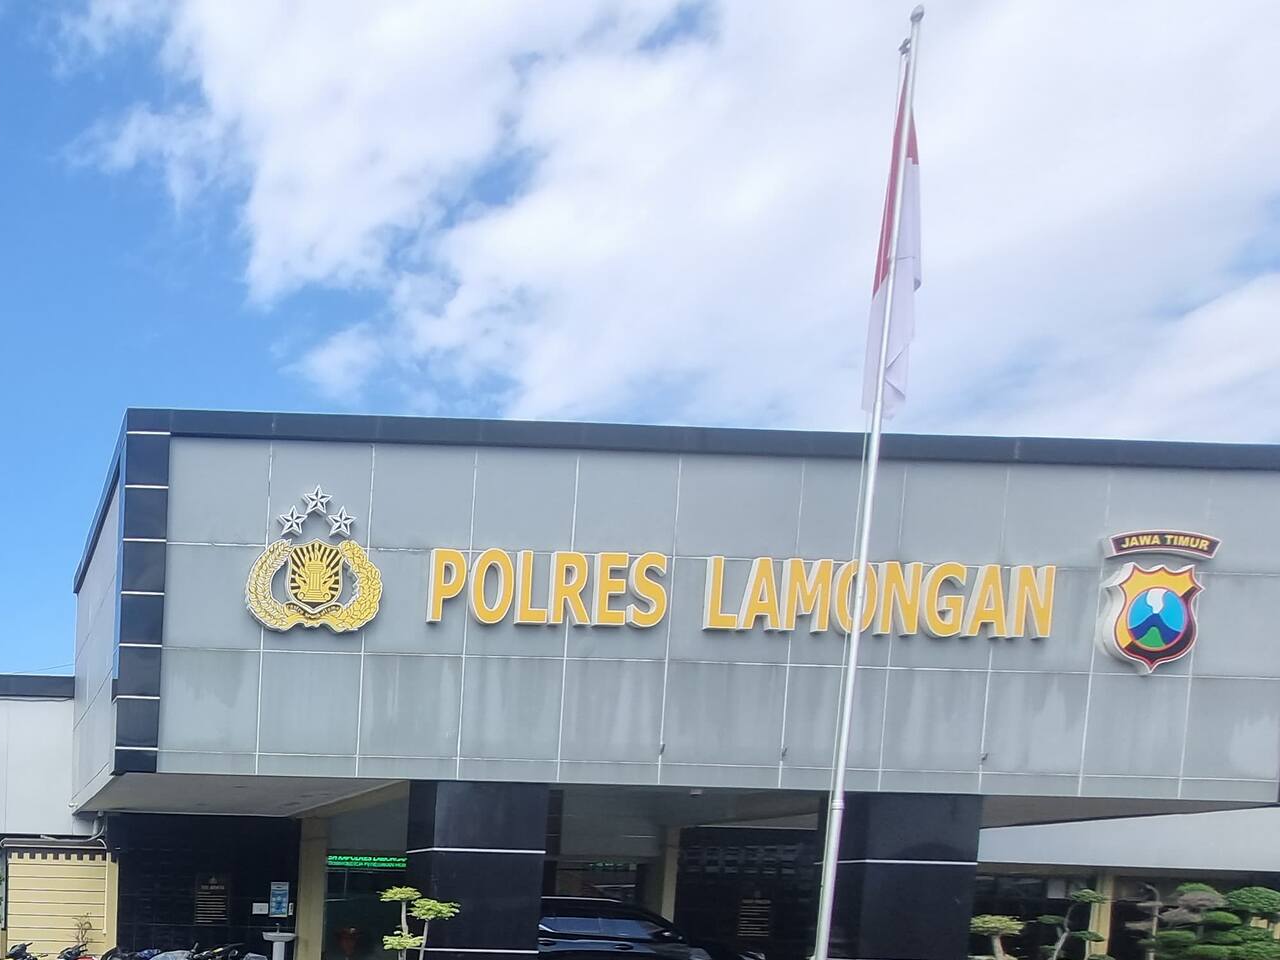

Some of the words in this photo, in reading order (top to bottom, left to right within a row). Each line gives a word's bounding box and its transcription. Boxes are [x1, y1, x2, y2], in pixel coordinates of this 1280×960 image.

[1121, 534, 1161, 548] JAWA
[1164, 534, 1211, 550] TIMUR
[426, 548, 667, 628] POLRES
[702, 556, 1056, 638] LAMONGAN
